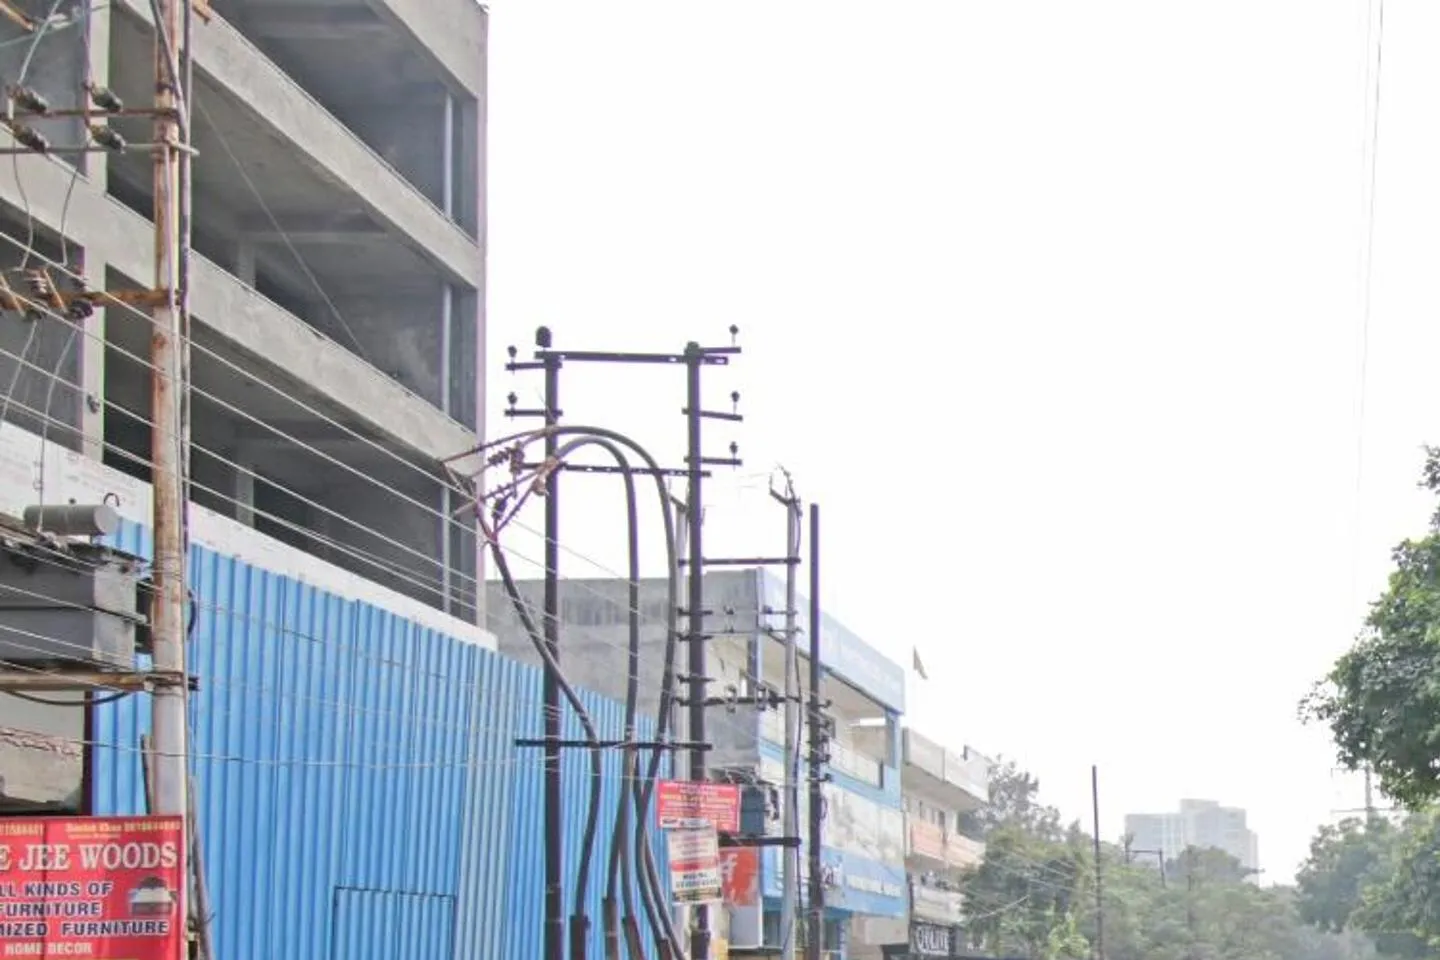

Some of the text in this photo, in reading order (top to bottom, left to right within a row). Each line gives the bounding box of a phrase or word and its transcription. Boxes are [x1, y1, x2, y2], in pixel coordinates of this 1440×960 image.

[18, 843, 72, 871] JEE
[79, 841, 178, 870] WOODS
[24, 881, 82, 898] KINDS
[88, 881, 113, 896] OF
[61, 919, 169, 937] FURNITURE
[5, 941, 93, 956] HOME DECOR
